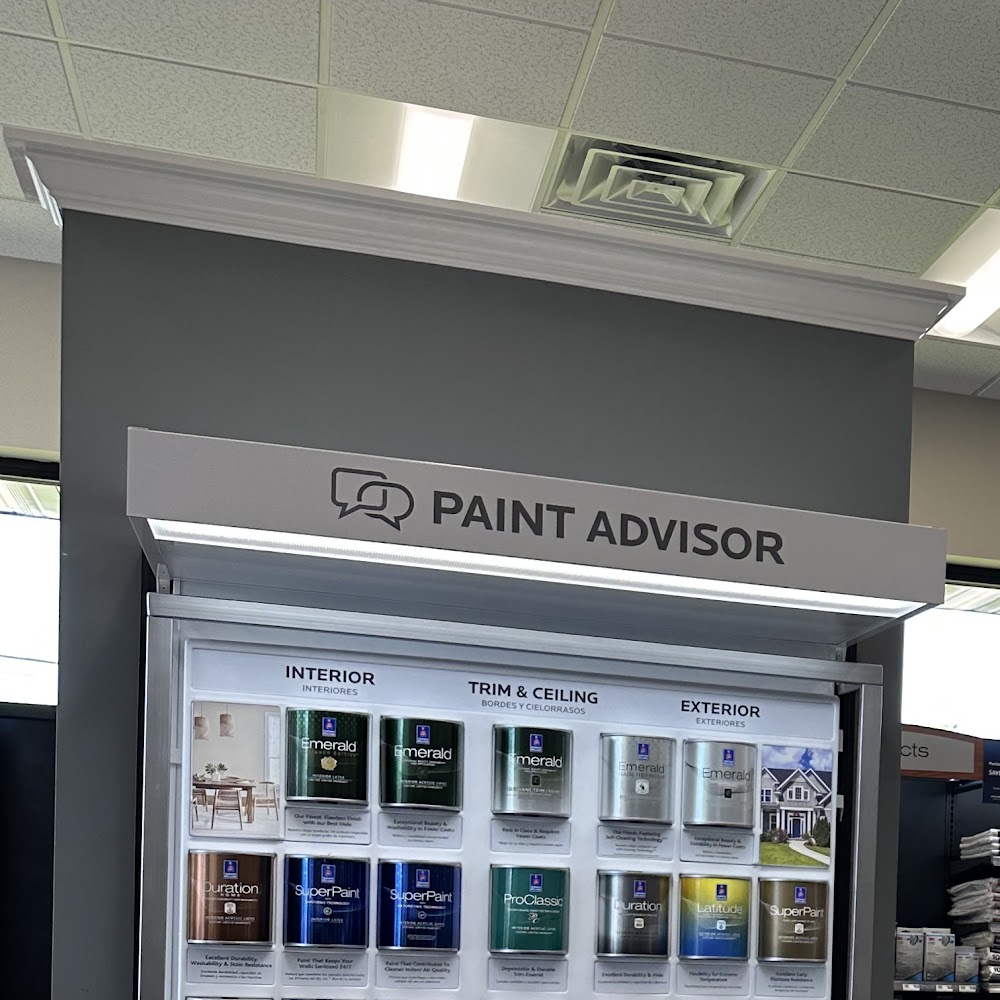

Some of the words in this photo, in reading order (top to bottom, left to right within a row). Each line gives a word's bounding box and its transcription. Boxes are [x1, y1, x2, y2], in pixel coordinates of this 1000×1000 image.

[433, 490, 576, 541] PAINT
[587, 511, 786, 565] ADVISOR
[286, 665, 375, 685] INTERIOR
[302, 685, 358, 696] INTERIORES
[468, 681, 511, 697] TRIM
[516, 686, 528, 698] &
[533, 687, 598, 704] CEILING
[481, 700, 517, 709] BORDES
[526, 703, 586, 715] CIELORRASOS
[681, 700, 761, 718] EXTERIOR
[696, 718, 746, 728] EXTERIORES
[301, 737, 357, 752] Emerald
[394, 745, 452, 760] Emerald
[618, 761, 665, 774] Emerald
[702, 767, 751, 781] Emerald
[202, 881, 259, 895] Duration
[294, 884, 361, 900] SuperPaint
[390, 888, 453, 903] SuperPaint
[504, 893, 564, 907] ProClassic
[697, 903, 743, 914] Latitude
